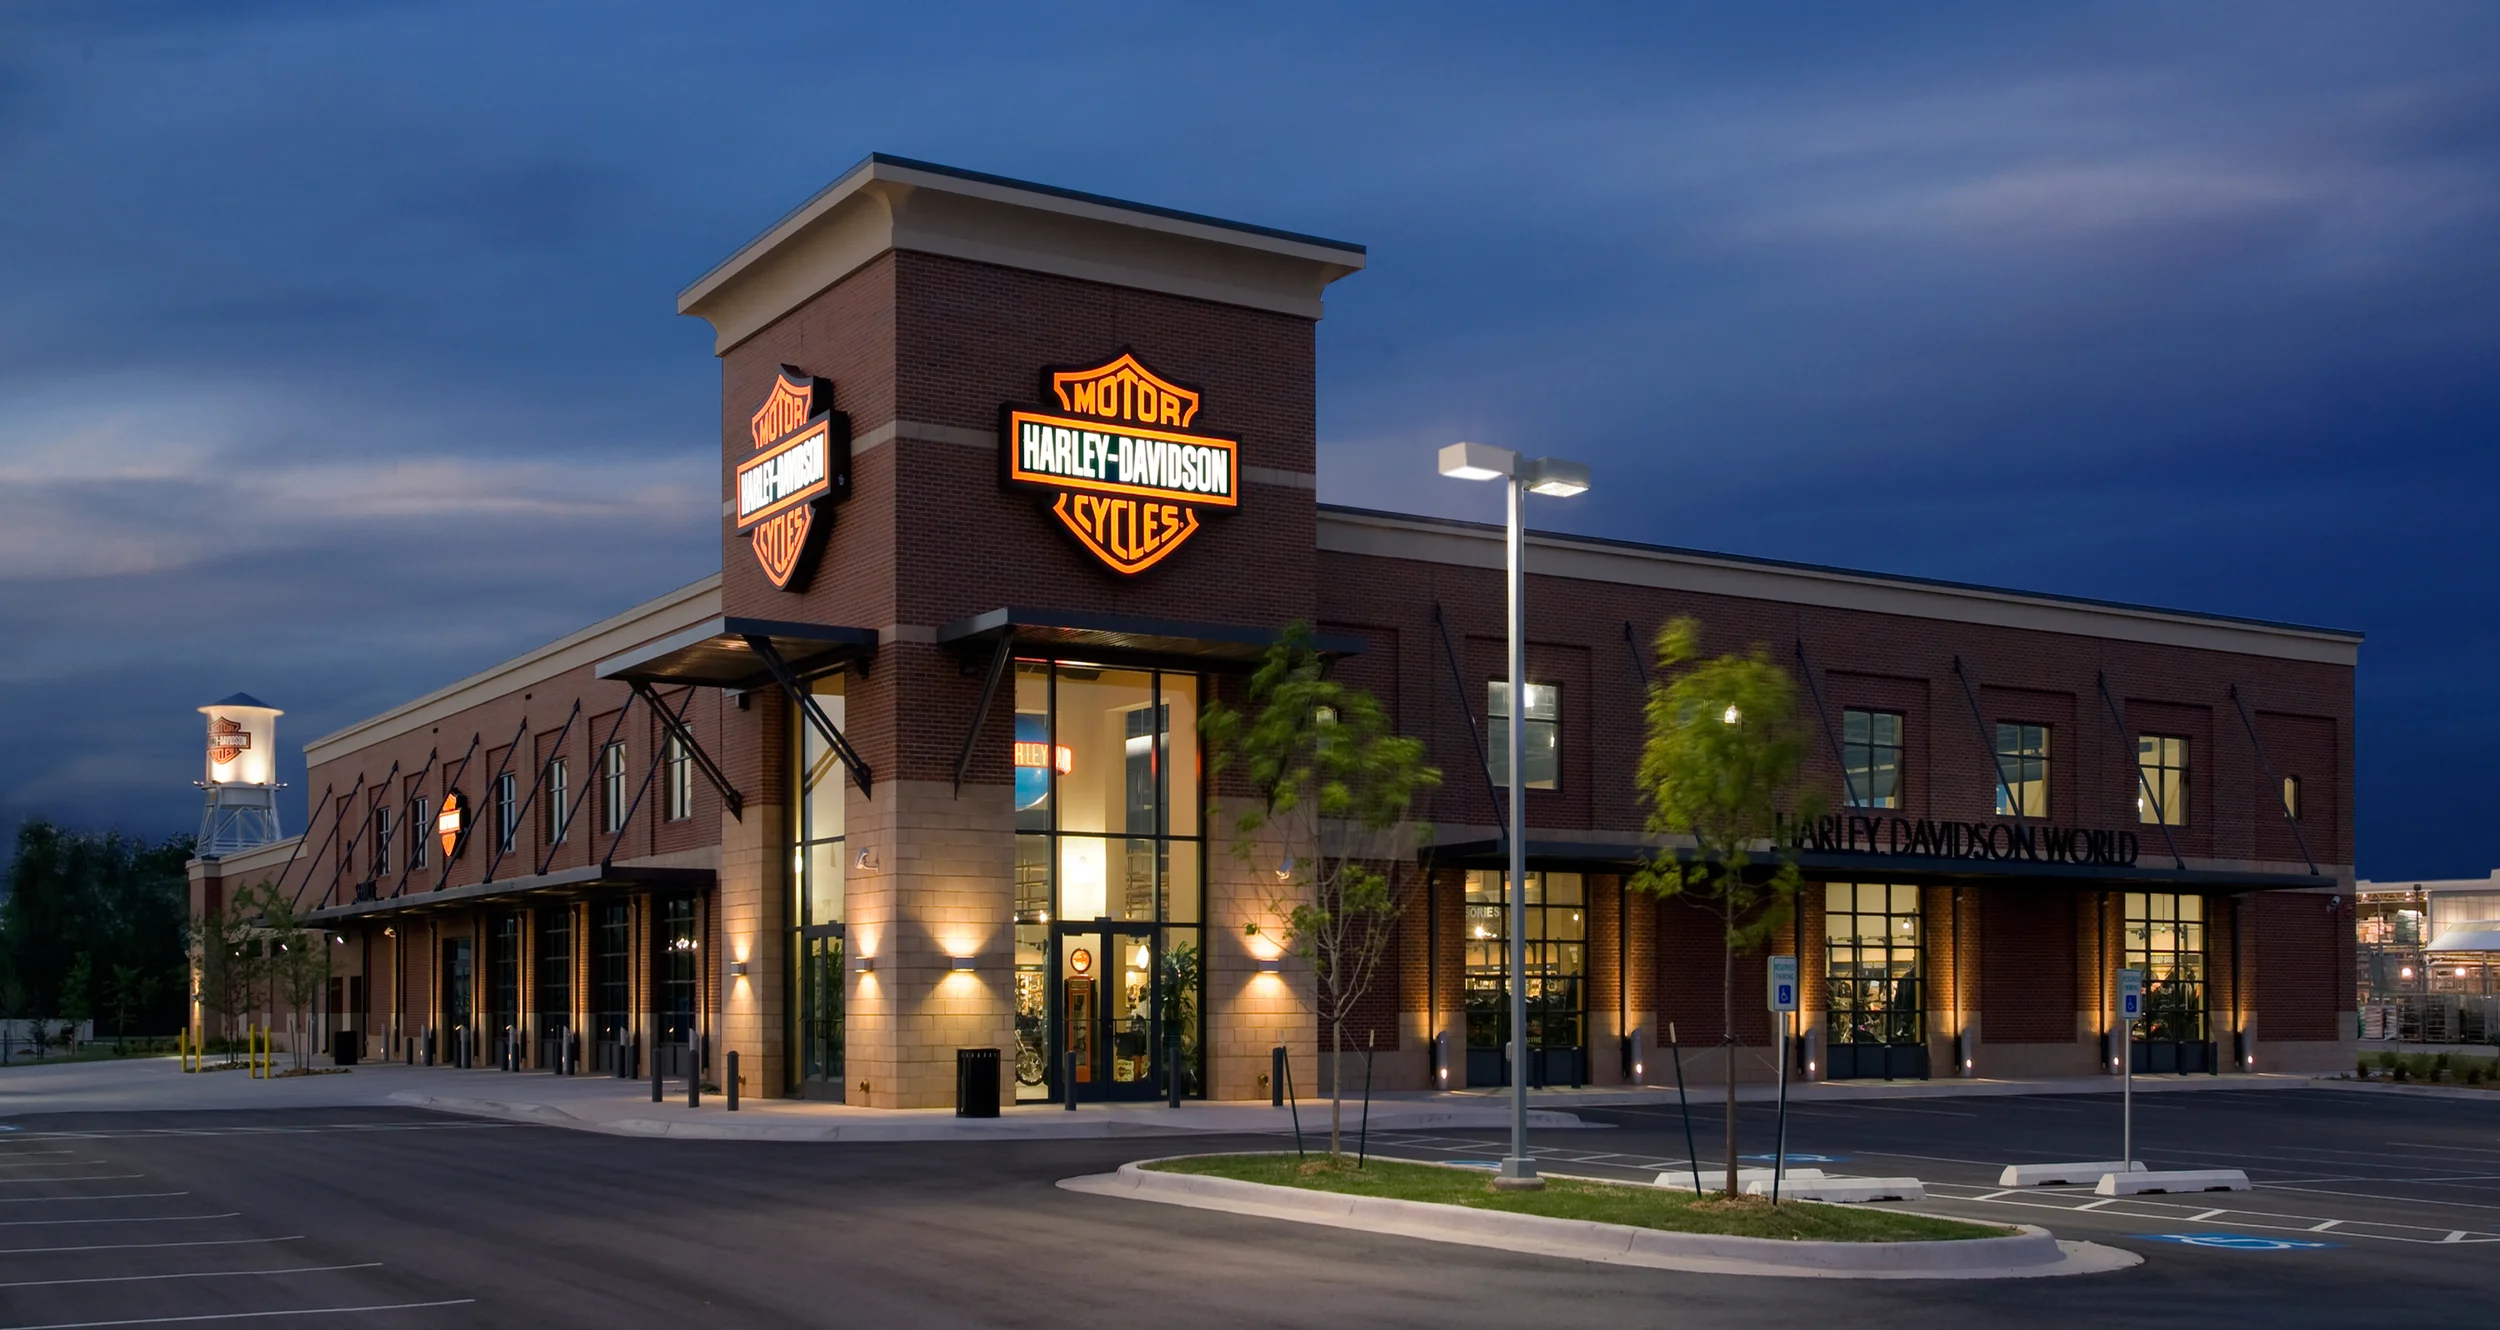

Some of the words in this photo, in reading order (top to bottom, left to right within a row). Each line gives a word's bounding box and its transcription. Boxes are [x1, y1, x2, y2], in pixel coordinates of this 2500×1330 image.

[759, 387, 804, 448] MOTOR
[1073, 367, 1181, 427] MOTOR
[741, 433, 824, 516] HARLEY-DAVIDSON
[1023, 423, 1228, 495] HARLEY-DAVIDSON
[759, 506, 803, 573] CYCLES
[1073, 494, 1179, 560] CYCLES
[1891, 817, 2037, 863] DAVIDSON
[2042, 826, 2139, 867] WORLD
